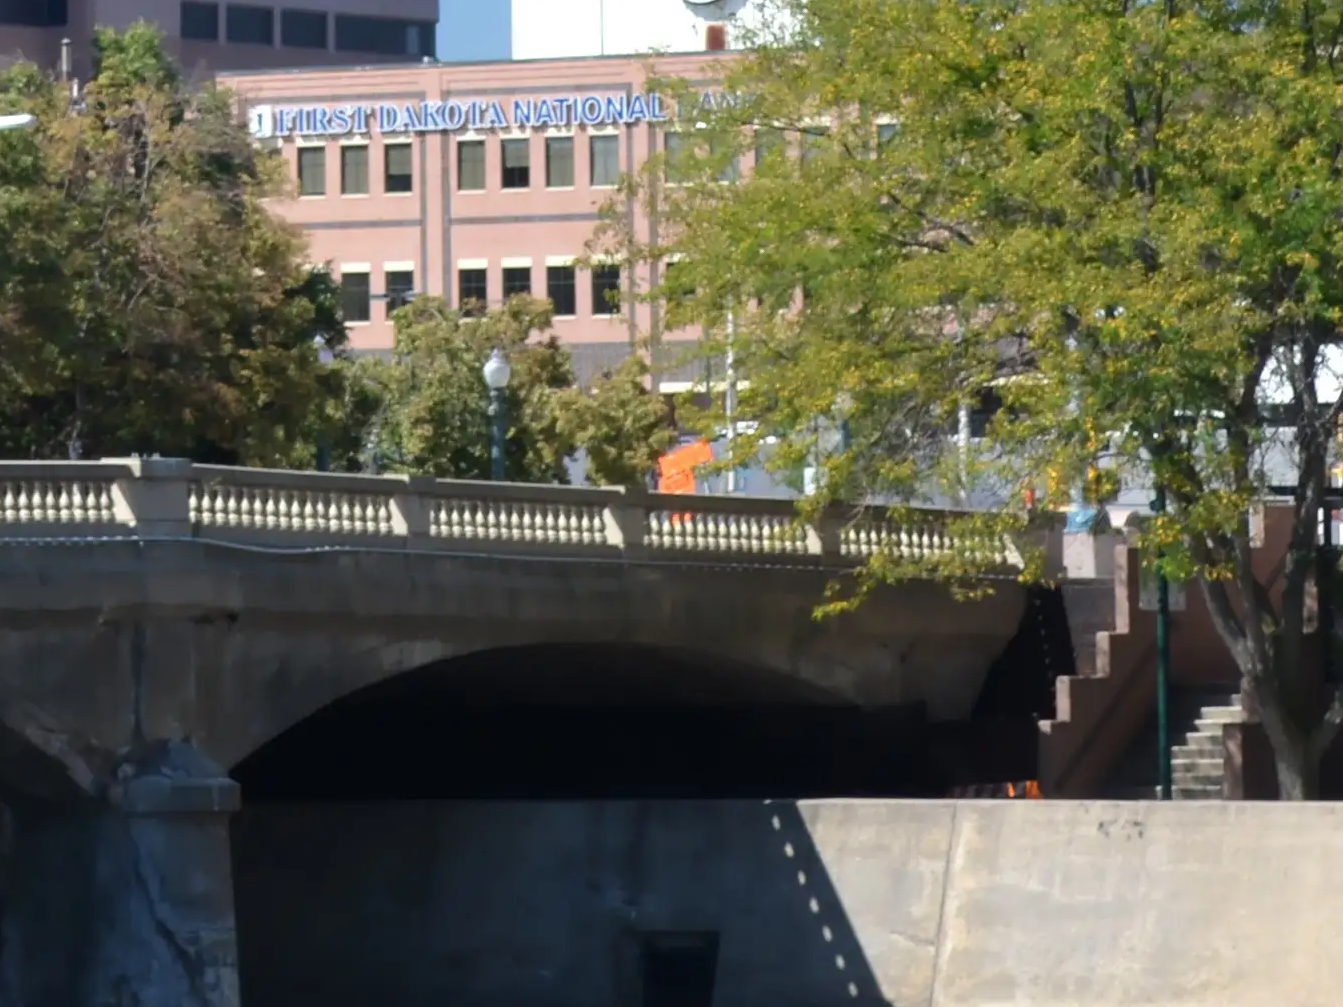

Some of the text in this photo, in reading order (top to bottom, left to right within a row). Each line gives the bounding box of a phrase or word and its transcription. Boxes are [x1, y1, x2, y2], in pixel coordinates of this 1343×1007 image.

[275, 103, 370, 136] FIRST
[376, 98, 507, 131] DAKOTA
[513, 92, 667, 127] NATIONAL
